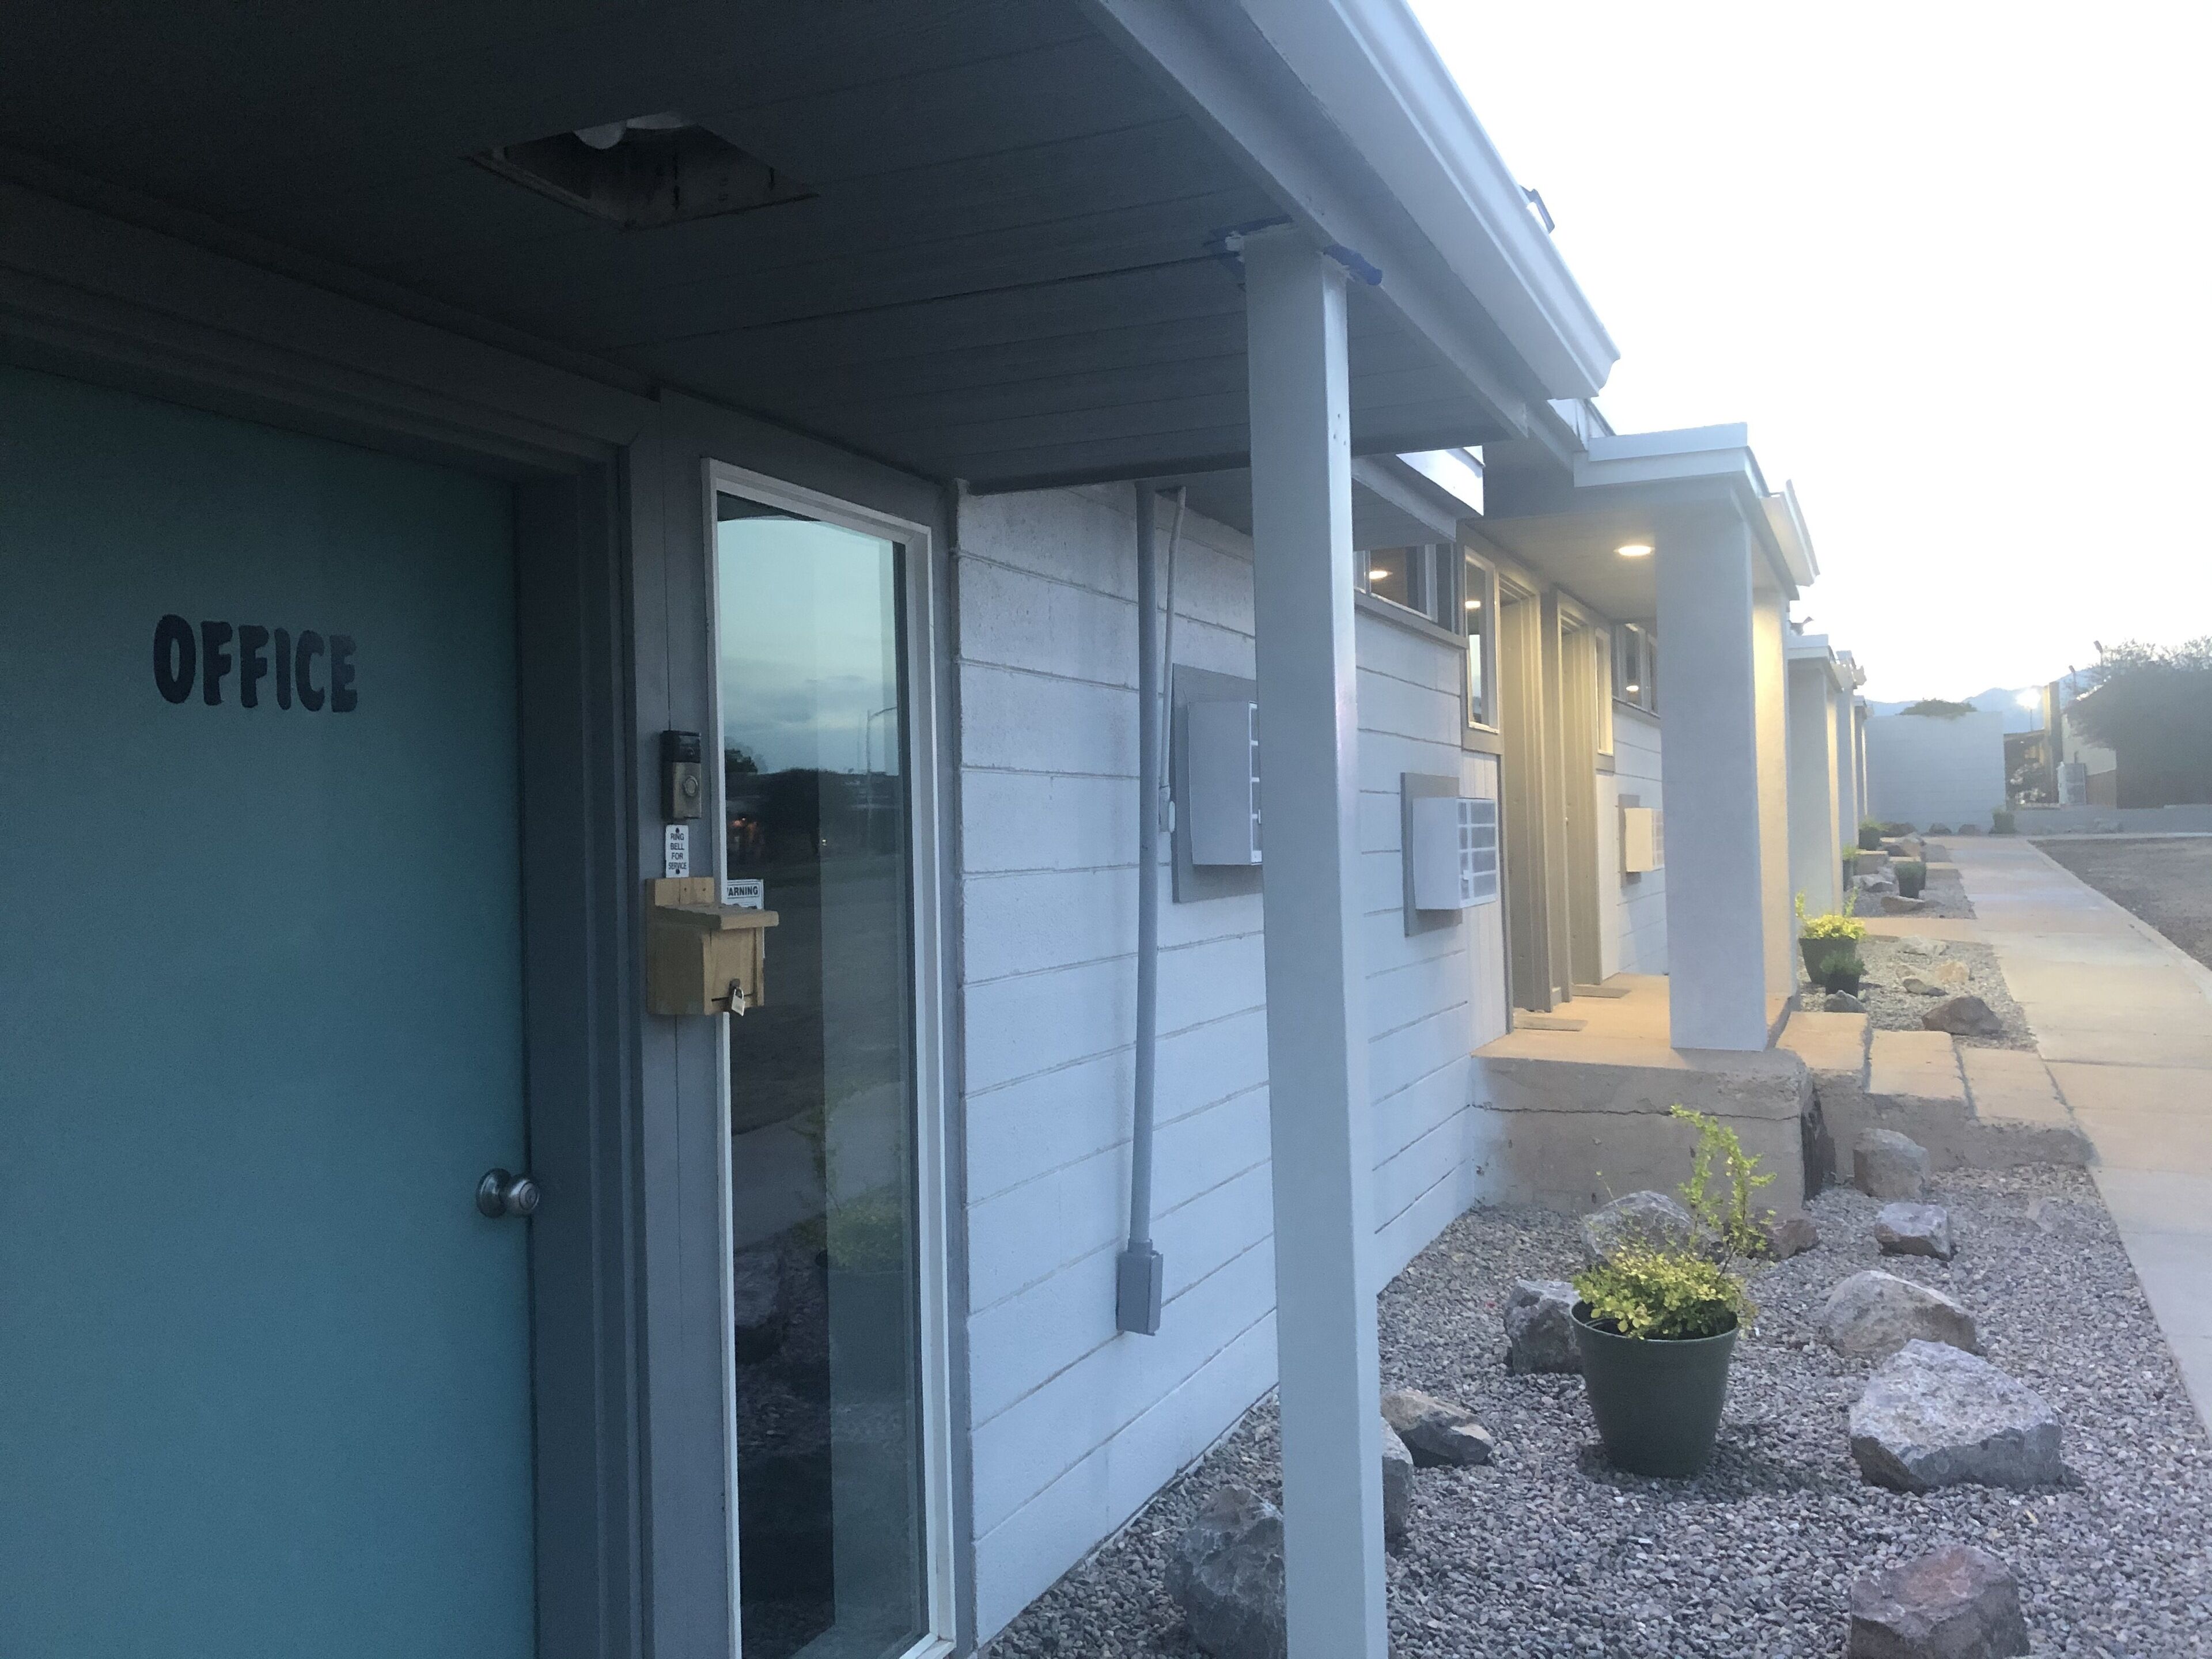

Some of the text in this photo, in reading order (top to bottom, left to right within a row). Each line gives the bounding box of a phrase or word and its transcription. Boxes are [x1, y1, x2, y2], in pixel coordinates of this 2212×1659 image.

[154, 614, 358, 713] OFFICE
[668, 862, 687, 870] SERVICE
[727, 886, 758, 896] ARNING
